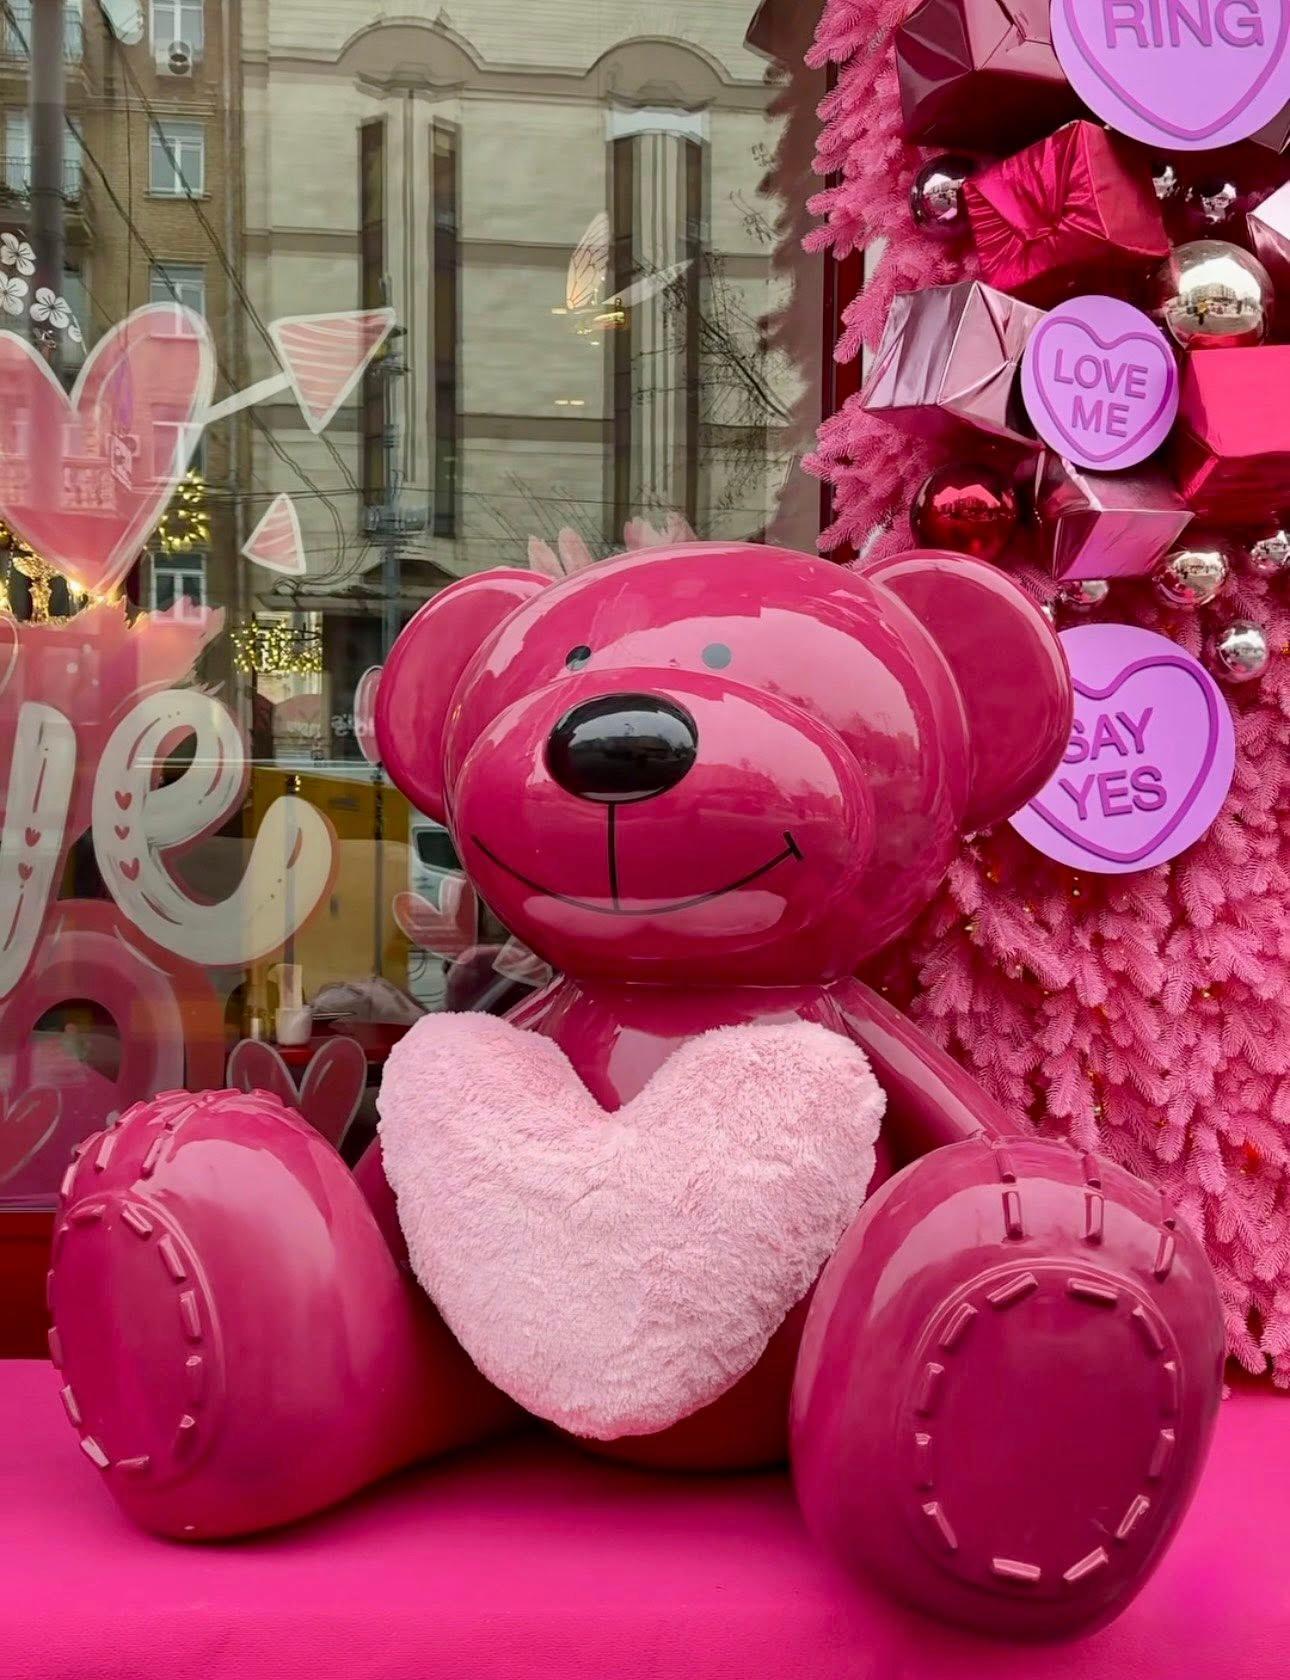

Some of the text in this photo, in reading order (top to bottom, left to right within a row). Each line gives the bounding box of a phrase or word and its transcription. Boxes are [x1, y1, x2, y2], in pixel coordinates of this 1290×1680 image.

[1102, 0, 1264, 48] RING
[1054, 348, 1149, 400] LOVE
[1071, 395, 1130, 438] ME
[1062, 707, 1153, 764] SAY
[1058, 765, 1167, 821] YES
